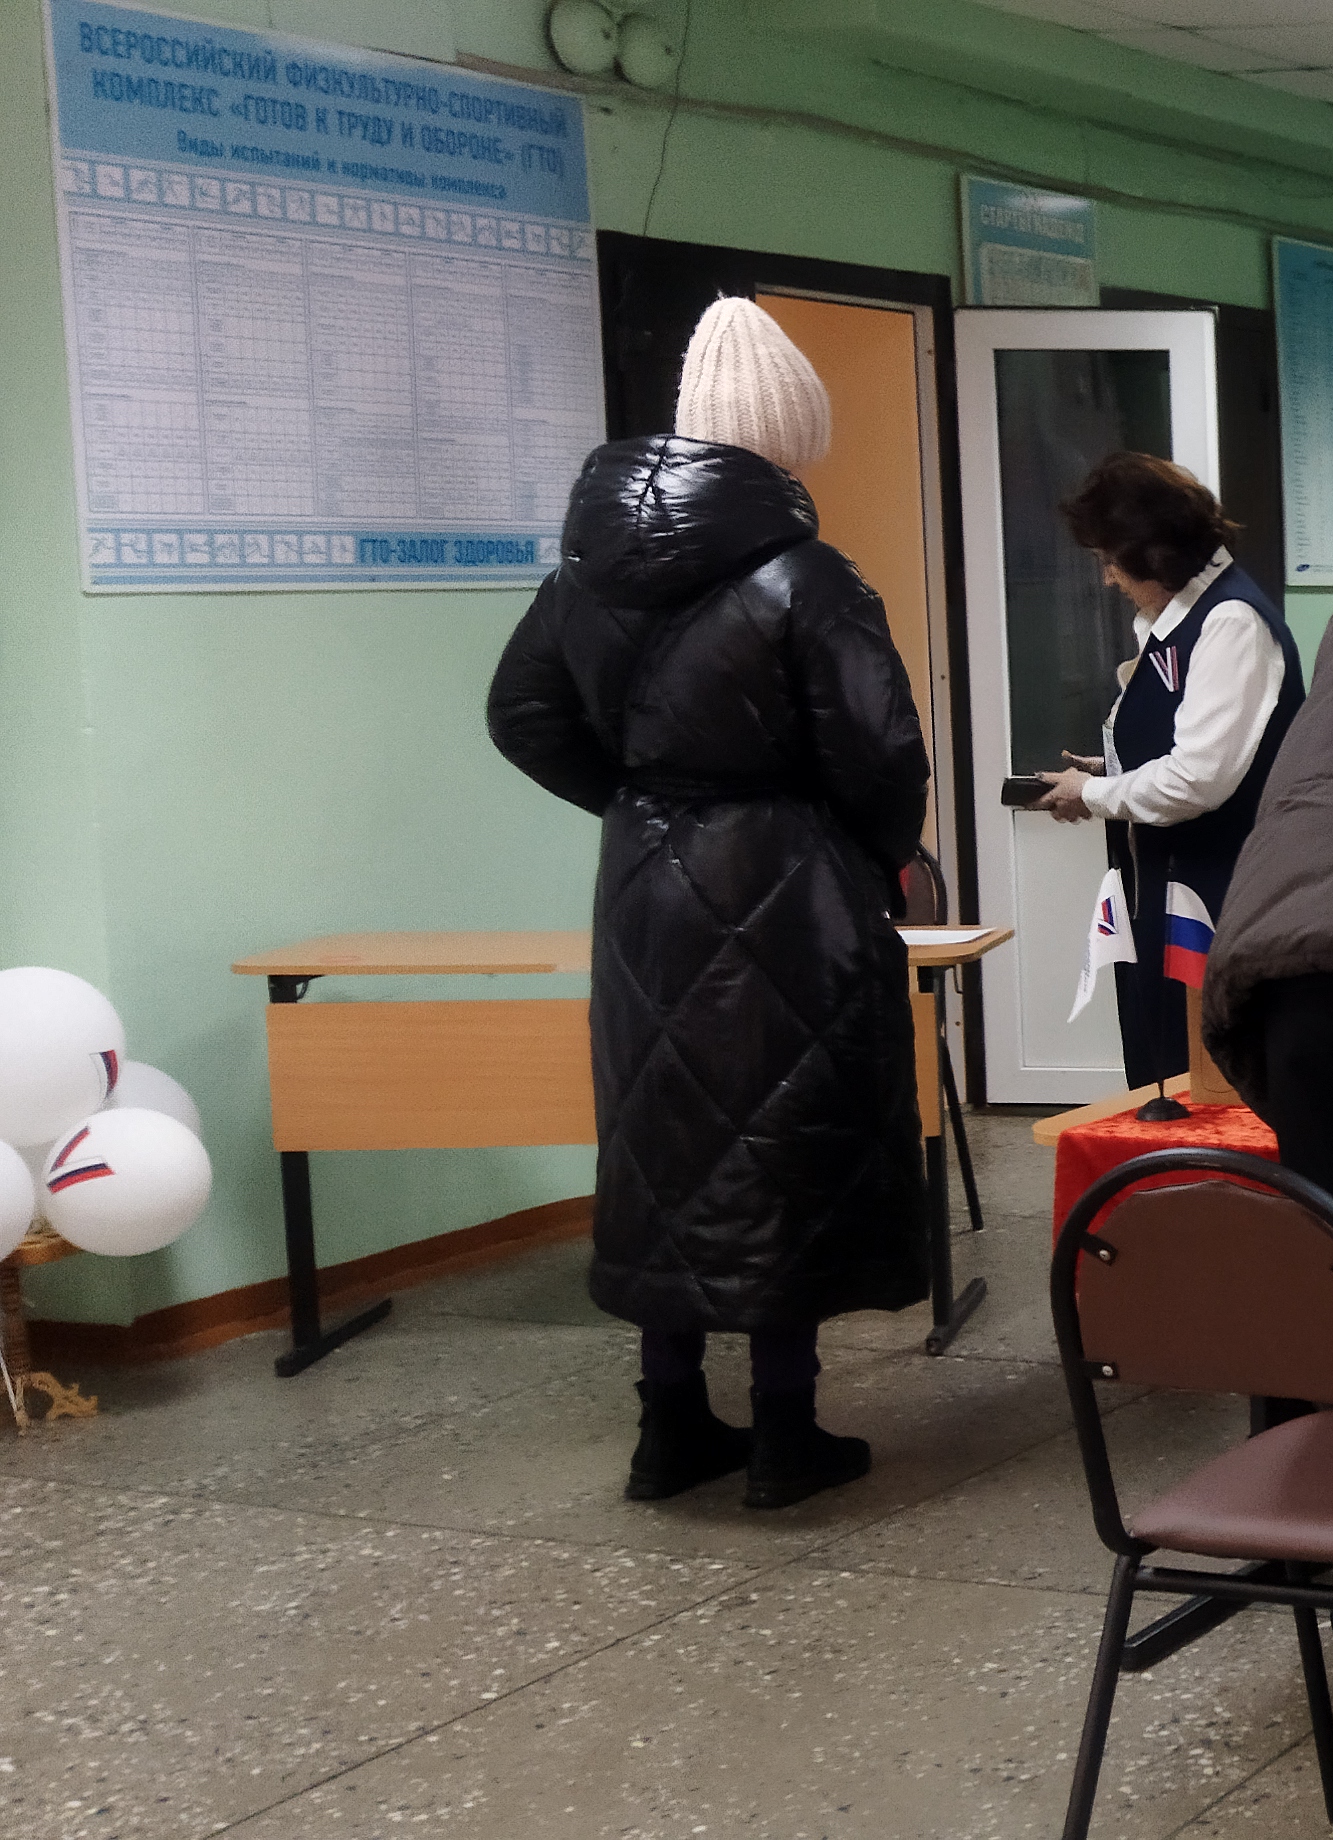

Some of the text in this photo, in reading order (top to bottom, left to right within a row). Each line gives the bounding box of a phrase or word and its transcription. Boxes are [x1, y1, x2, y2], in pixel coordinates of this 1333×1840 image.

[79, 21, 568, 138] ВСЕРОССИЙСКИЙ ФИЗКУЛЬТУРНО-СПОРТИВНЫЙ
[92, 68, 566, 179] КОМПЛЕКС «ГОТОВ К ТРУДУ И ОБОРОНЕ» (ГТО)
[176, 129, 224, 158] Виды
[360, 538, 535, 567] ГТО-ЗАЛОГ ЗДОРОВЬЯ
